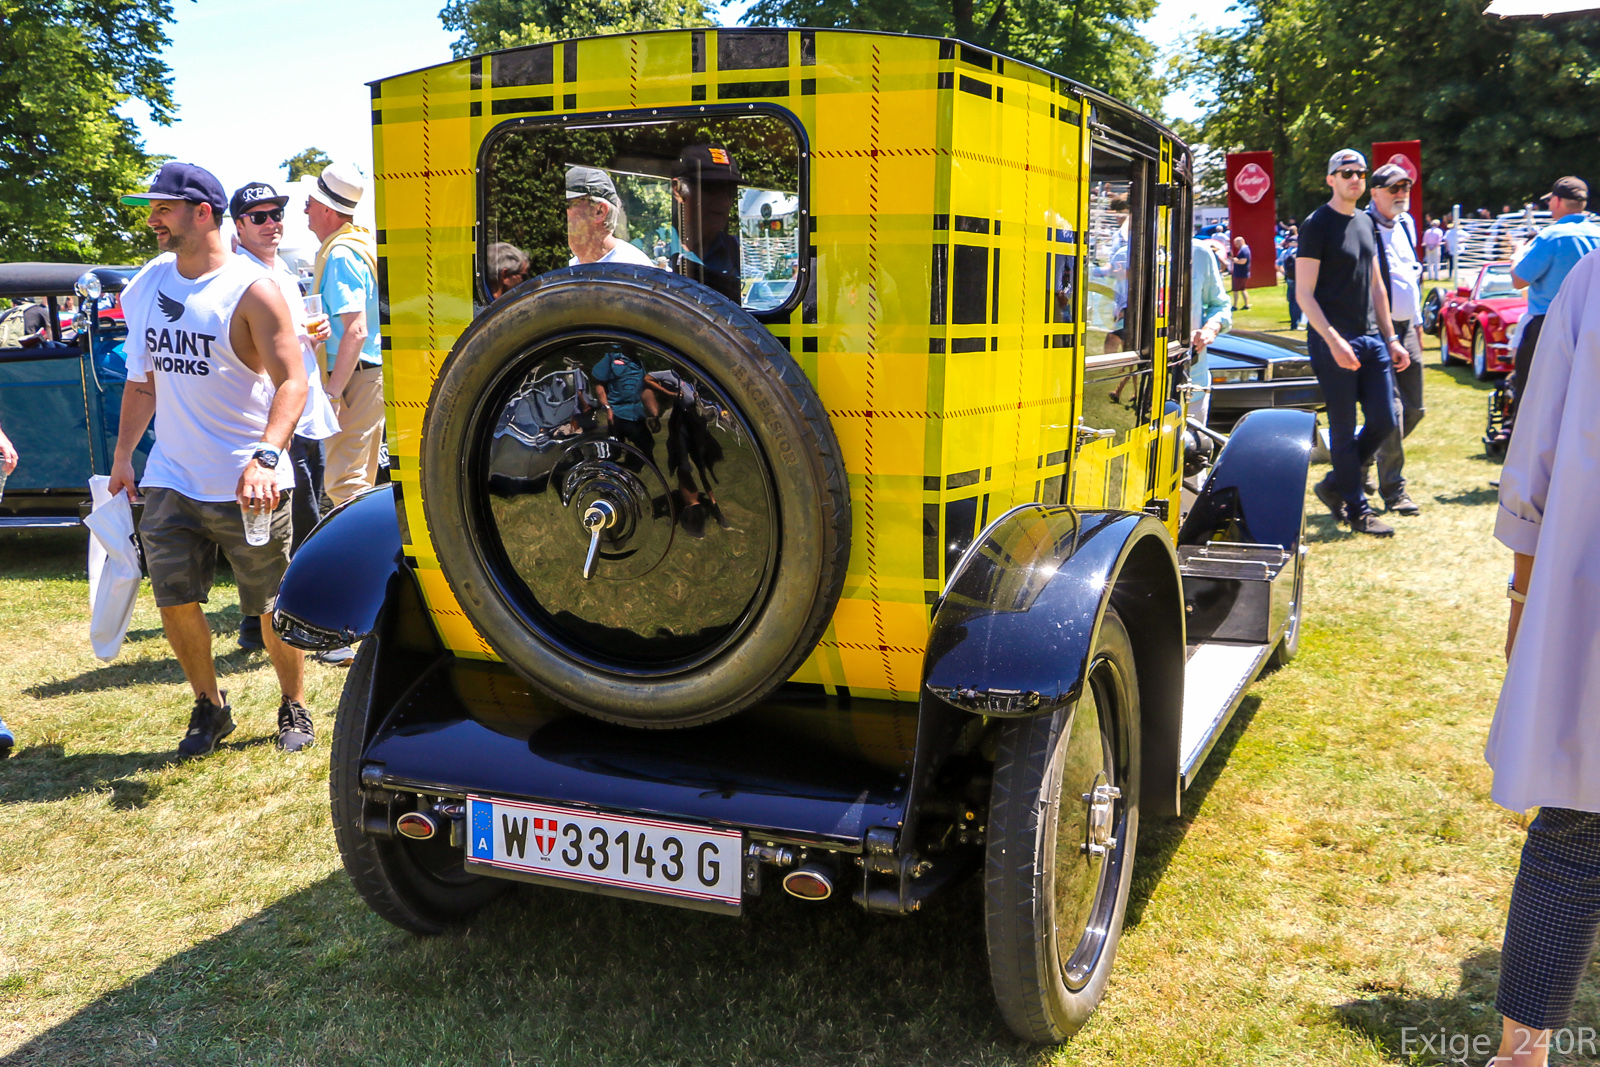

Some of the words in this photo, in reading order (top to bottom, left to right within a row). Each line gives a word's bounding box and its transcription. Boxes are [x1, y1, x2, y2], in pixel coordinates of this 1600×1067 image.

[145, 327, 217, 358] SAINT
[152, 355, 210, 377] WORKS
[729, 362, 799, 467] EXCELSIOR
[478, 837, 488, 851] A
[501, 812, 529, 860] W
[561, 822, 684, 882] 33143
[697, 841, 720, 887] G
